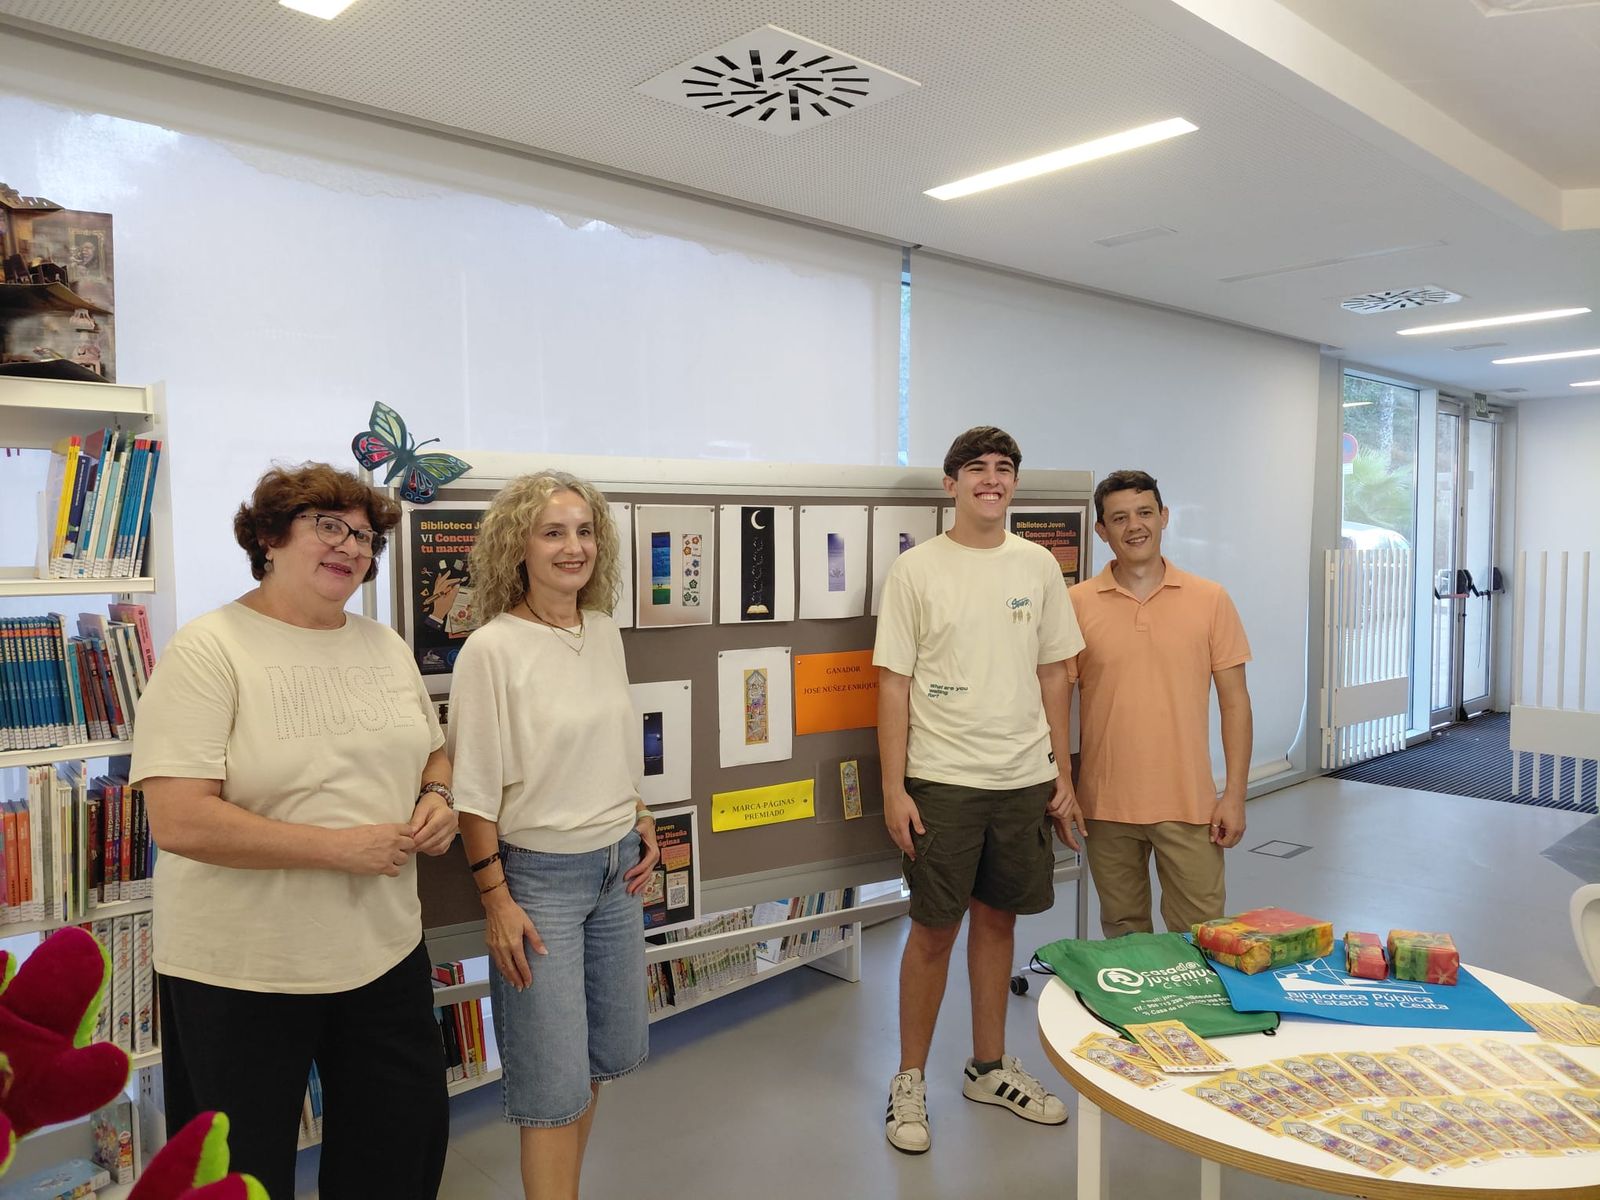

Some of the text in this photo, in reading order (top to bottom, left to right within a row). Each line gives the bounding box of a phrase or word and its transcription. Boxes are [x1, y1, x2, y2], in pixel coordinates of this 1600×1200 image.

[420, 521, 472, 530] Biblioteca
[1016, 521, 1048, 529] Biblioteca
[420, 534, 432, 542] VI
[826, 666, 862, 674] GANADOR
[264, 665, 415, 740] MUSE
[744, 808, 784, 820] PREMIADO
[1163, 976, 1214, 990] CEUTA
[1286, 992, 1434, 1003] Biblioteca Pública
[1399, 1002, 1450, 1010] Ceuta
